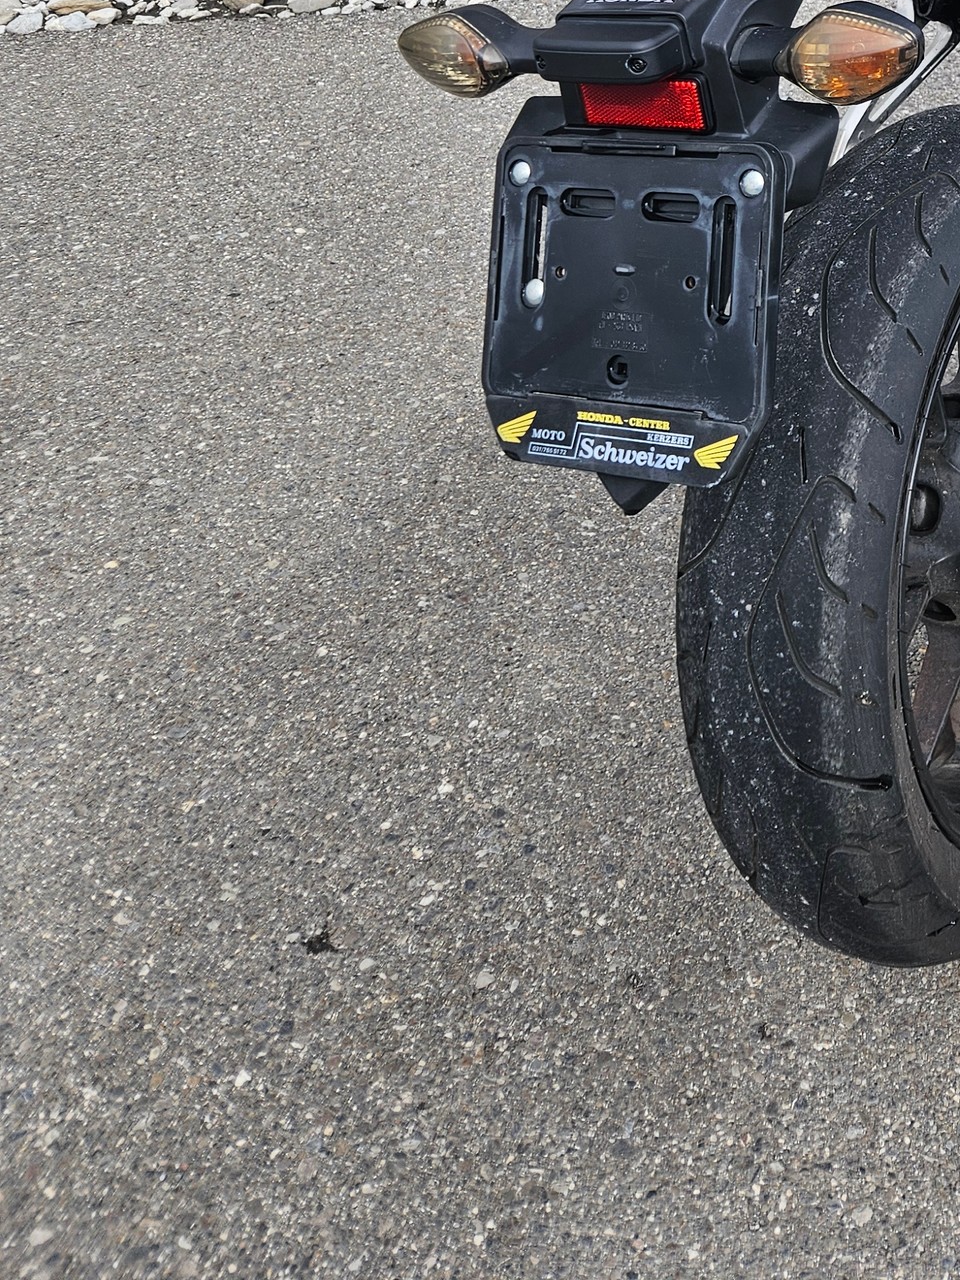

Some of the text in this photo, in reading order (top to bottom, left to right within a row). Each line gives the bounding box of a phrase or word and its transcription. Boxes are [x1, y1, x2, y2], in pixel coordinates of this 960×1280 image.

[576, 411, 671, 431] HONDA-CENTER
[531, 428, 566, 441] MOTO
[646, 433, 690, 446] KERZERS
[578, 437, 690, 471] Schweizer
